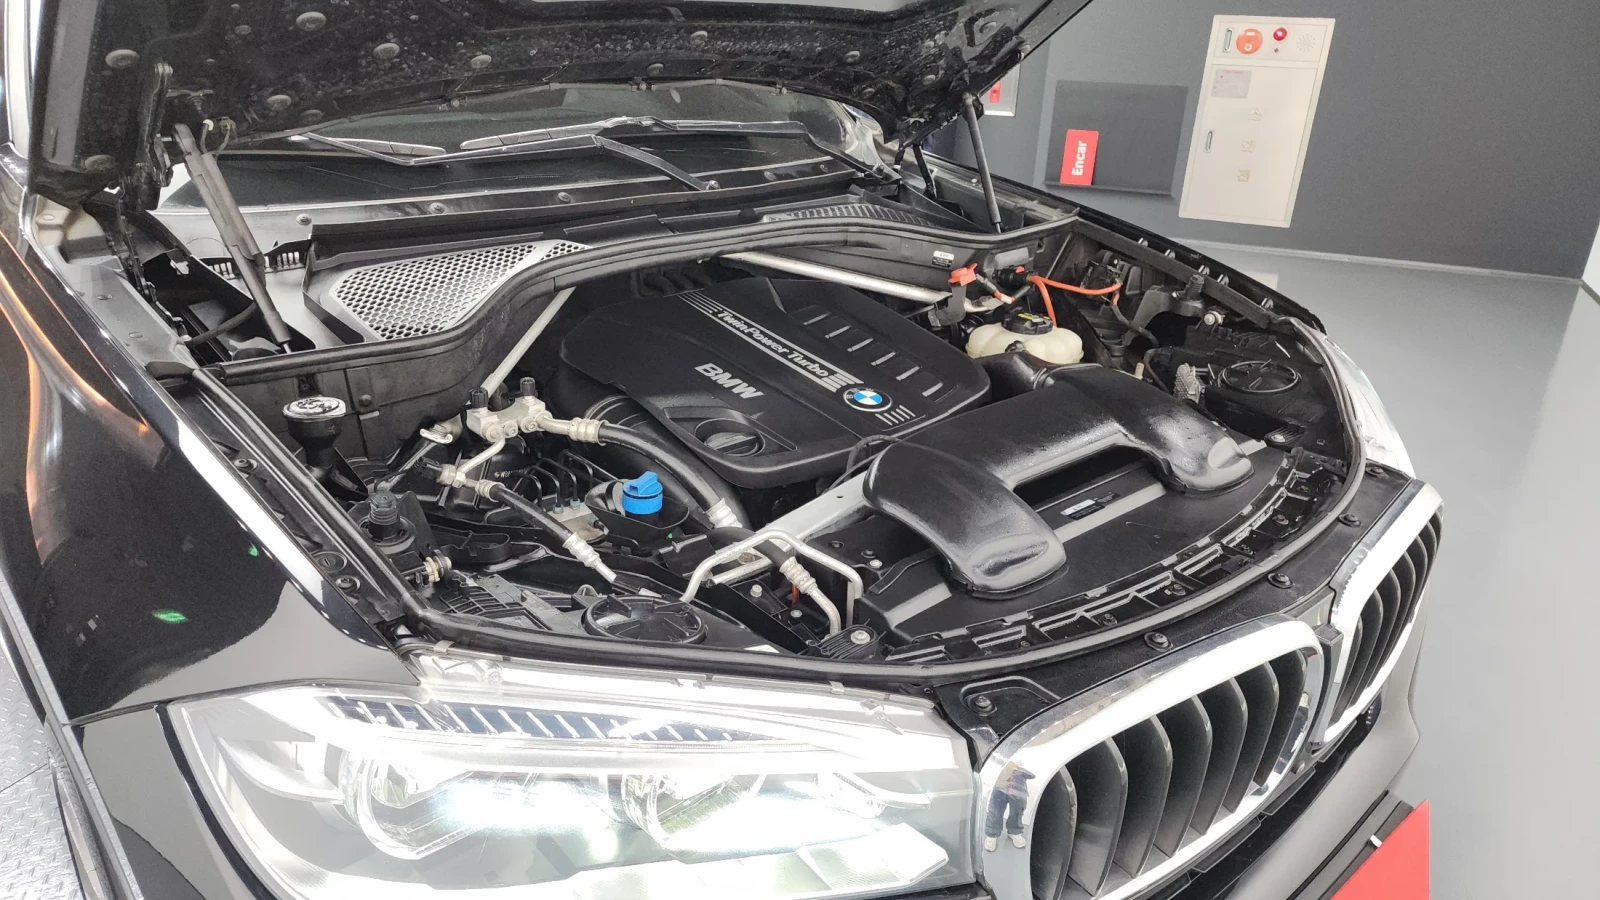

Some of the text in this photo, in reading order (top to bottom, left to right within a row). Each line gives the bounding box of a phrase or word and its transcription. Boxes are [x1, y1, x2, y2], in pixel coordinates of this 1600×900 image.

[1071, 139, 1087, 176] Encar
[716, 310, 829, 377] TwinPower Turbo
[694, 362, 765, 399] BMW
